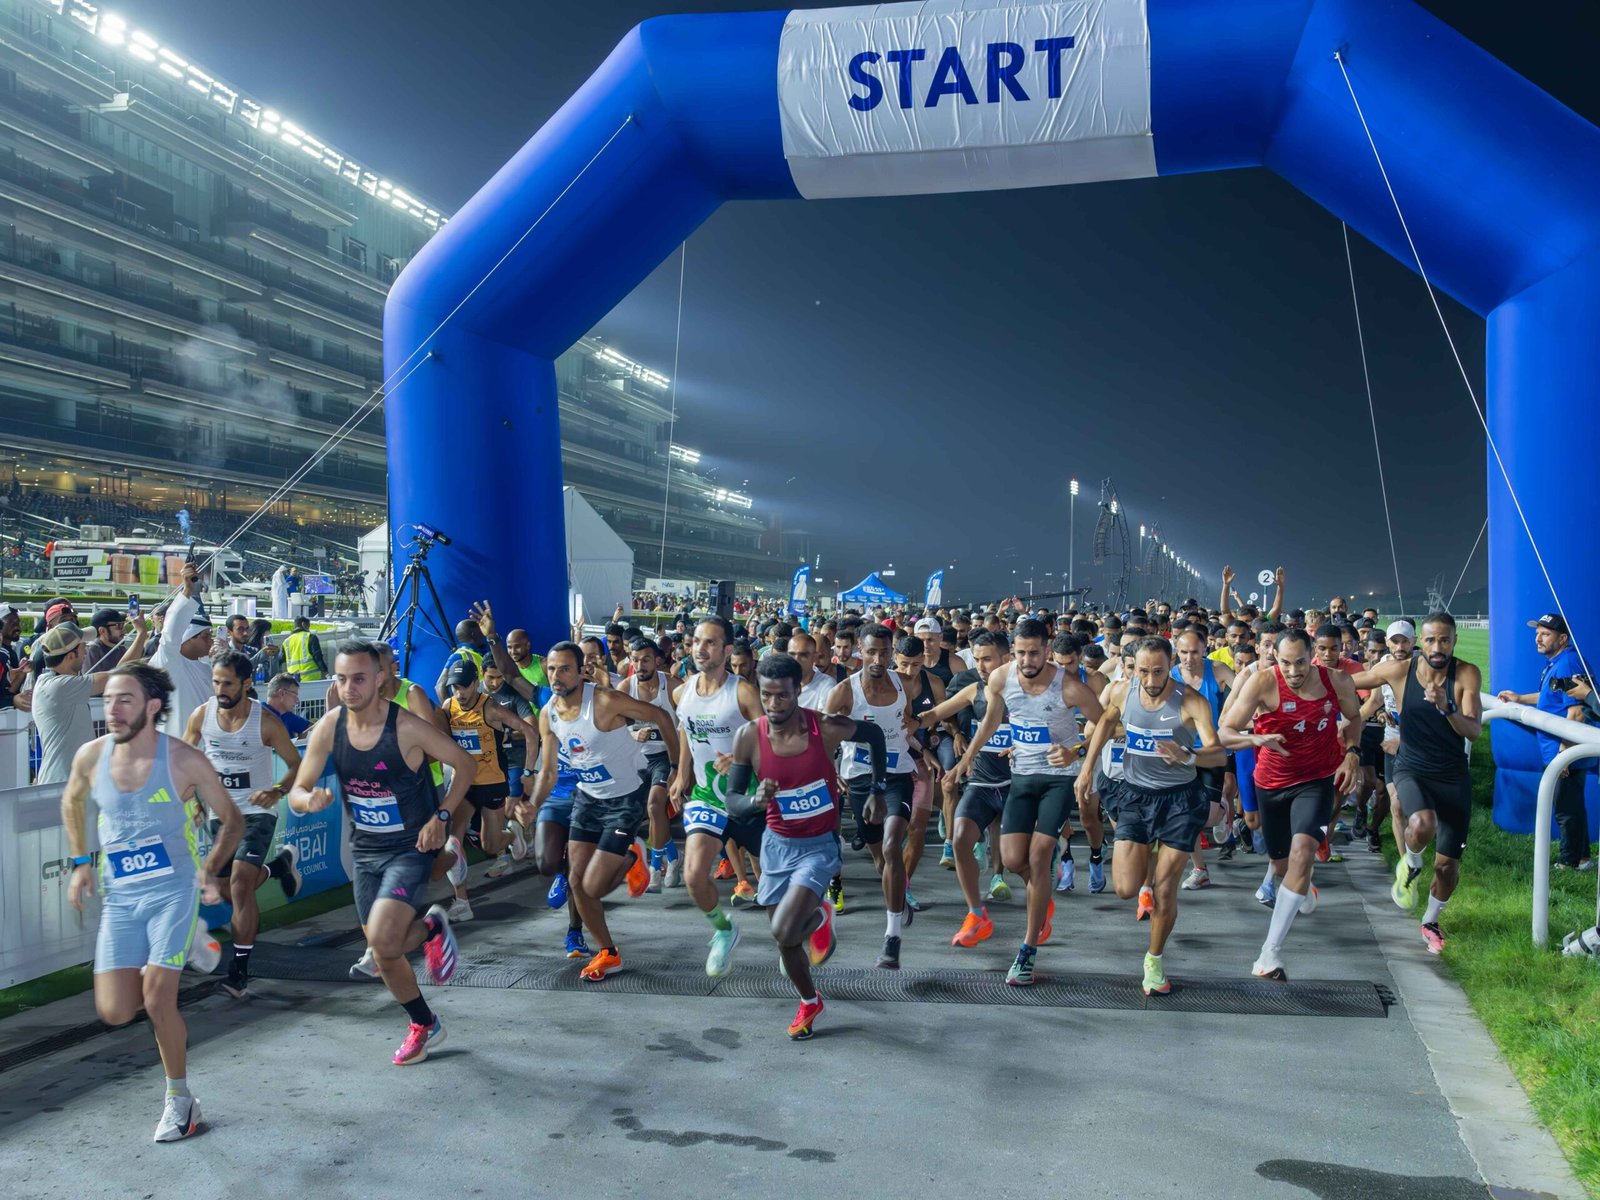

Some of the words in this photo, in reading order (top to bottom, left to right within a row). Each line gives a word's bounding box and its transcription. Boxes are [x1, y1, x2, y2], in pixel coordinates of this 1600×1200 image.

[848, 36, 1075, 112] START
[1262, 572, 1270, 583] 2
[697, 726, 731, 734] RUNNERS
[1292, 720, 1306, 733] 4
[1317, 718, 1329, 732] 6
[1016, 729, 1041, 742] 787
[1135, 738, 1157, 750] 47
[580, 771, 603, 782] 534
[790, 795, 820, 812] 480
[360, 809, 390, 824] 530
[691, 810, 718, 824] 761
[121, 851, 159, 873] 802
[303, 860, 329, 876] COUNCIL
